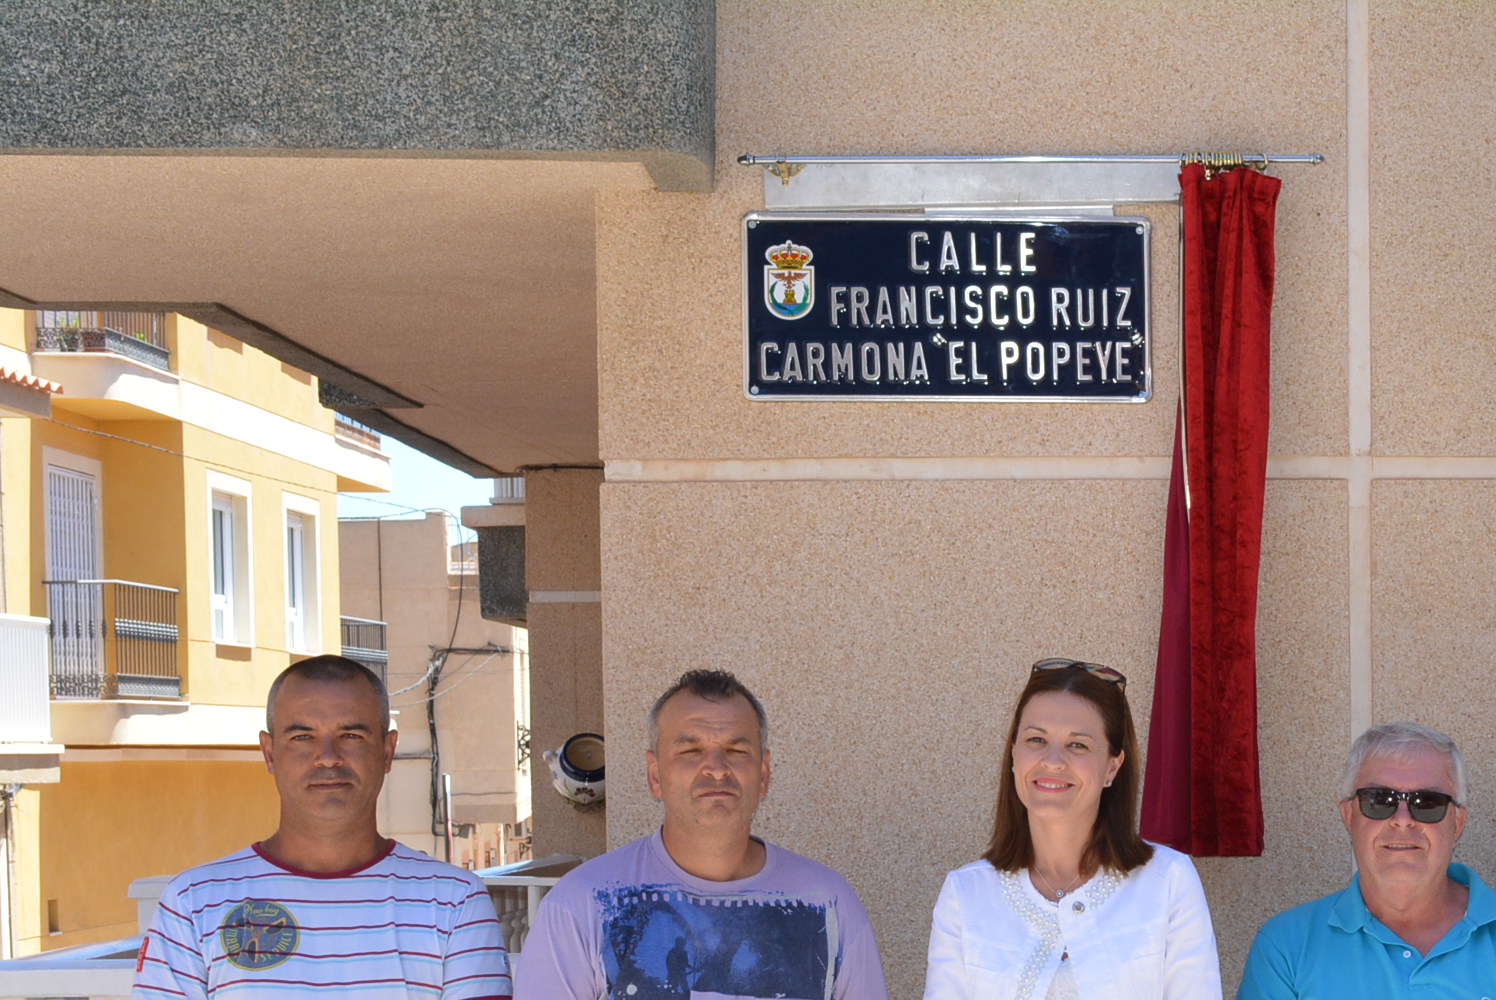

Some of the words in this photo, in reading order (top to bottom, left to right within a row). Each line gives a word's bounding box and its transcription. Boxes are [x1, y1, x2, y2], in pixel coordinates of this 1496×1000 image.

[909, 230, 1037, 275] CALLE
[829, 284, 1036, 328] FRANCISCO
[1050, 285, 1133, 329] RUIZ
[758, 340, 930, 384] CARMONA
